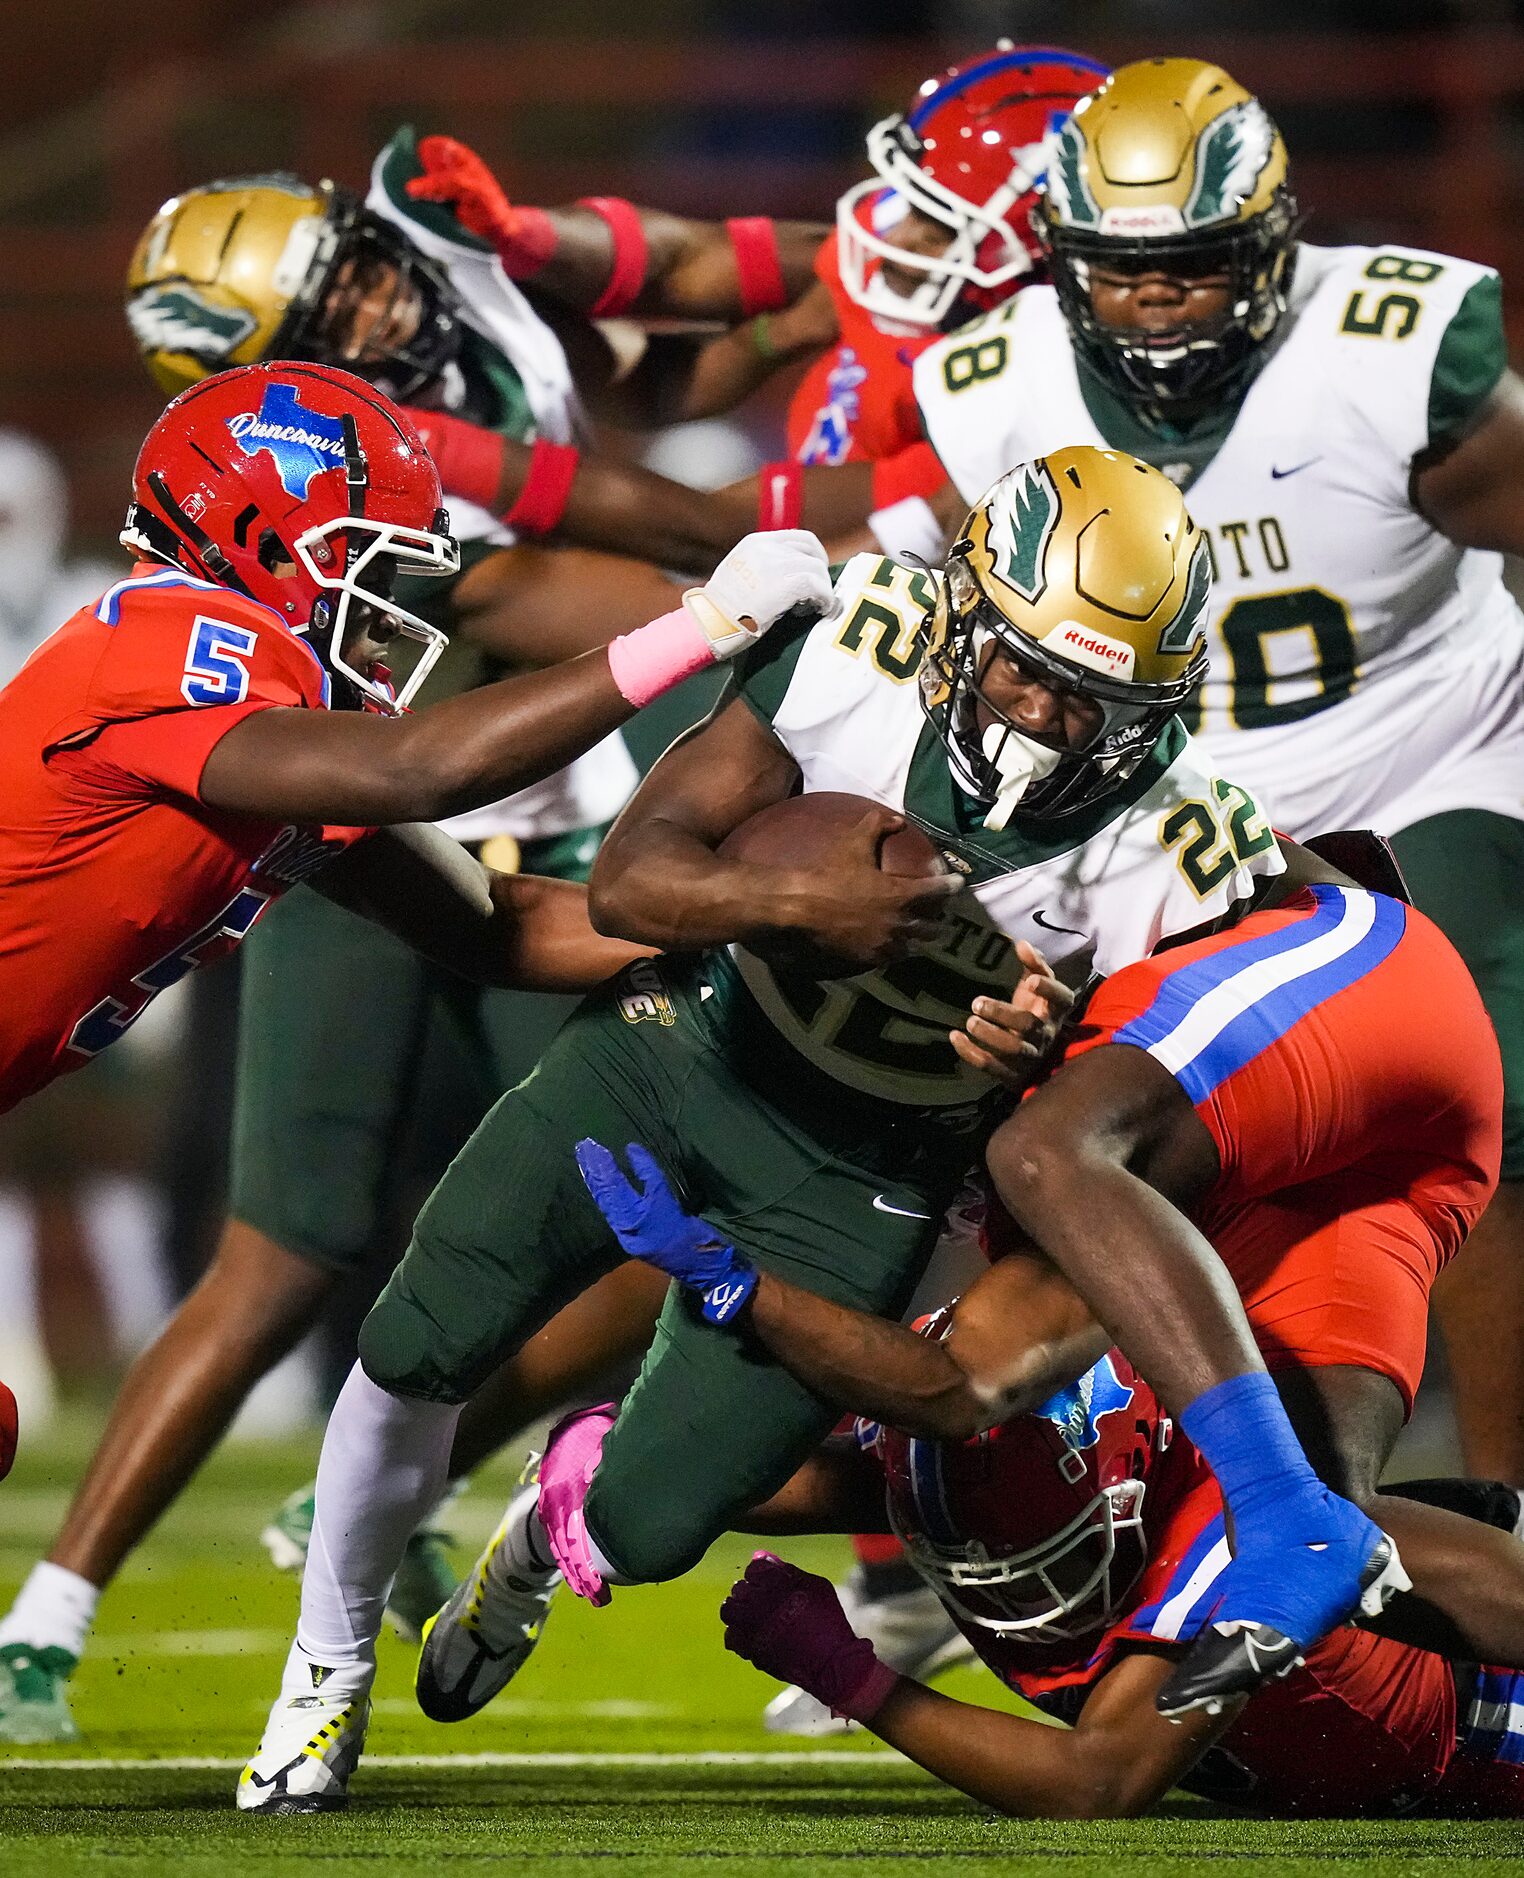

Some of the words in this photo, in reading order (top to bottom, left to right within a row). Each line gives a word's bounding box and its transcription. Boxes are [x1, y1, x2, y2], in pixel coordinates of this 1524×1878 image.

[1340, 254, 1444, 340] 58
[180, 614, 259, 707] 5
[1064, 629, 1130, 665] Riddell
[1158, 776, 1277, 904] 22
